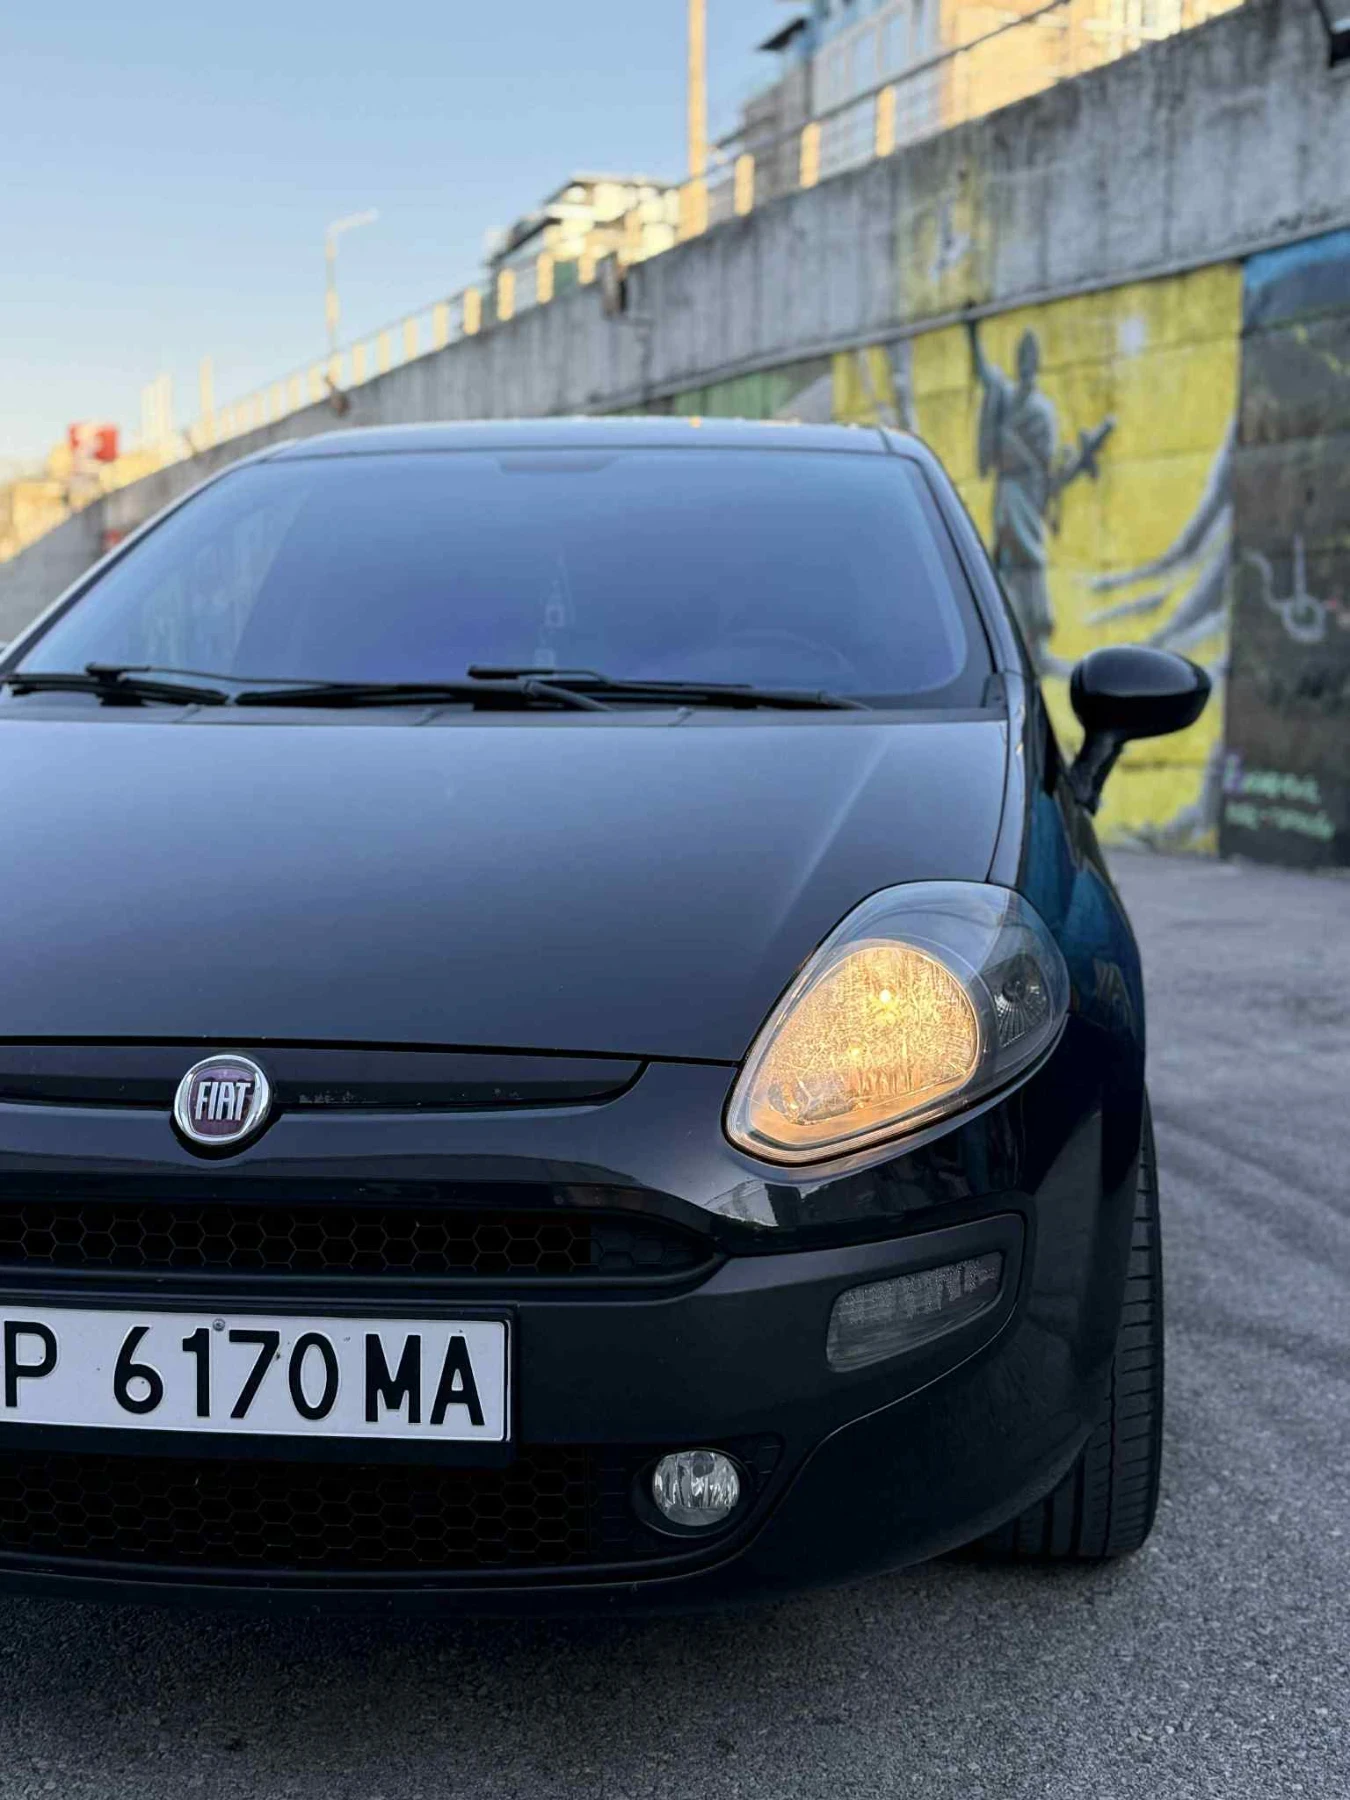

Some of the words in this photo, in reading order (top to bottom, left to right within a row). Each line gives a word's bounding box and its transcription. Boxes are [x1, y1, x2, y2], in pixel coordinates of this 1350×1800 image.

[195, 1081, 251, 1121] FIAT
[3, 1320, 57, 1408] P
[113, 1325, 340, 1420] 6170
[364, 1332, 486, 1426] MA
